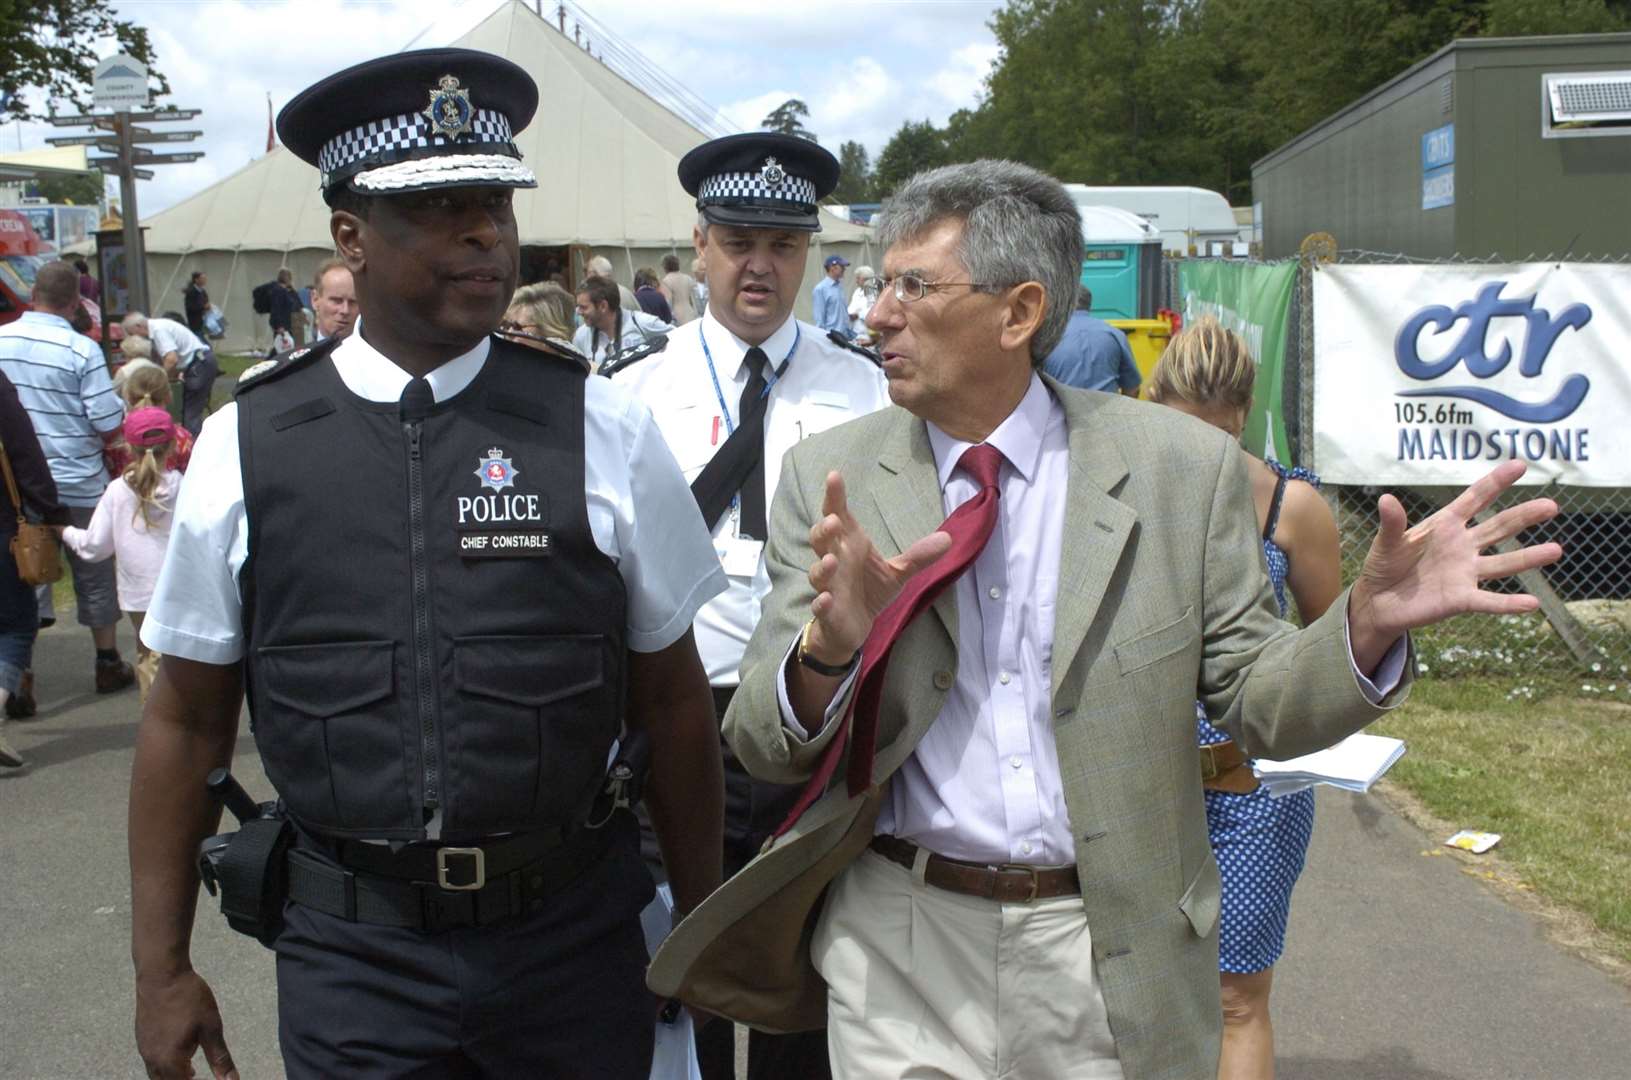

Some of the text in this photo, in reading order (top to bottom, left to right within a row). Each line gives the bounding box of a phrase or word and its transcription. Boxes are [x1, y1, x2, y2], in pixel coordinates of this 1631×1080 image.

[1394, 281, 1592, 381] ctr
[1394, 402, 1474, 425] 105.6fm
[1397, 428, 1590, 462] MAIDSTONE
[458, 495, 541, 523] POLICE
[461, 536, 549, 549] CHIEF CONSTABLE
